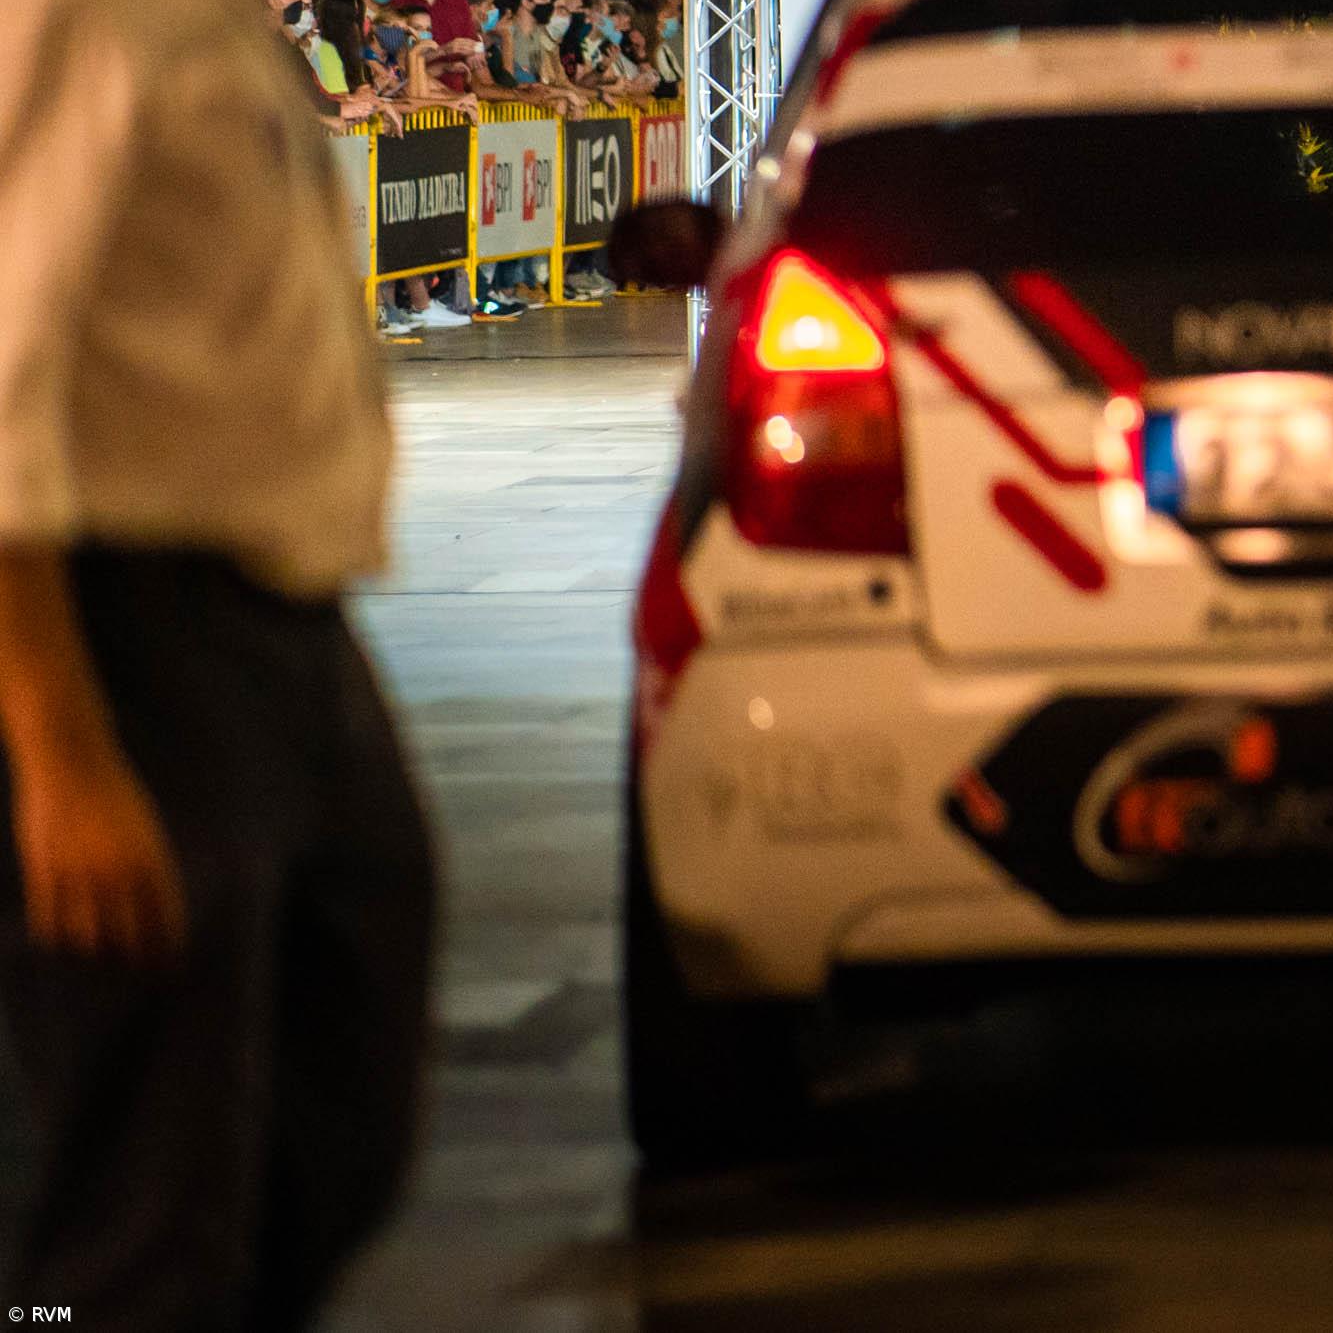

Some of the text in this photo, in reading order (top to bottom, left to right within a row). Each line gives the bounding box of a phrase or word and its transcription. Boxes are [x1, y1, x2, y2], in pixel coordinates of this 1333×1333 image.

[381, 179, 417, 225] VINHO
[418, 170, 466, 220] MADEIRA
[576, 134, 620, 225] MEO
